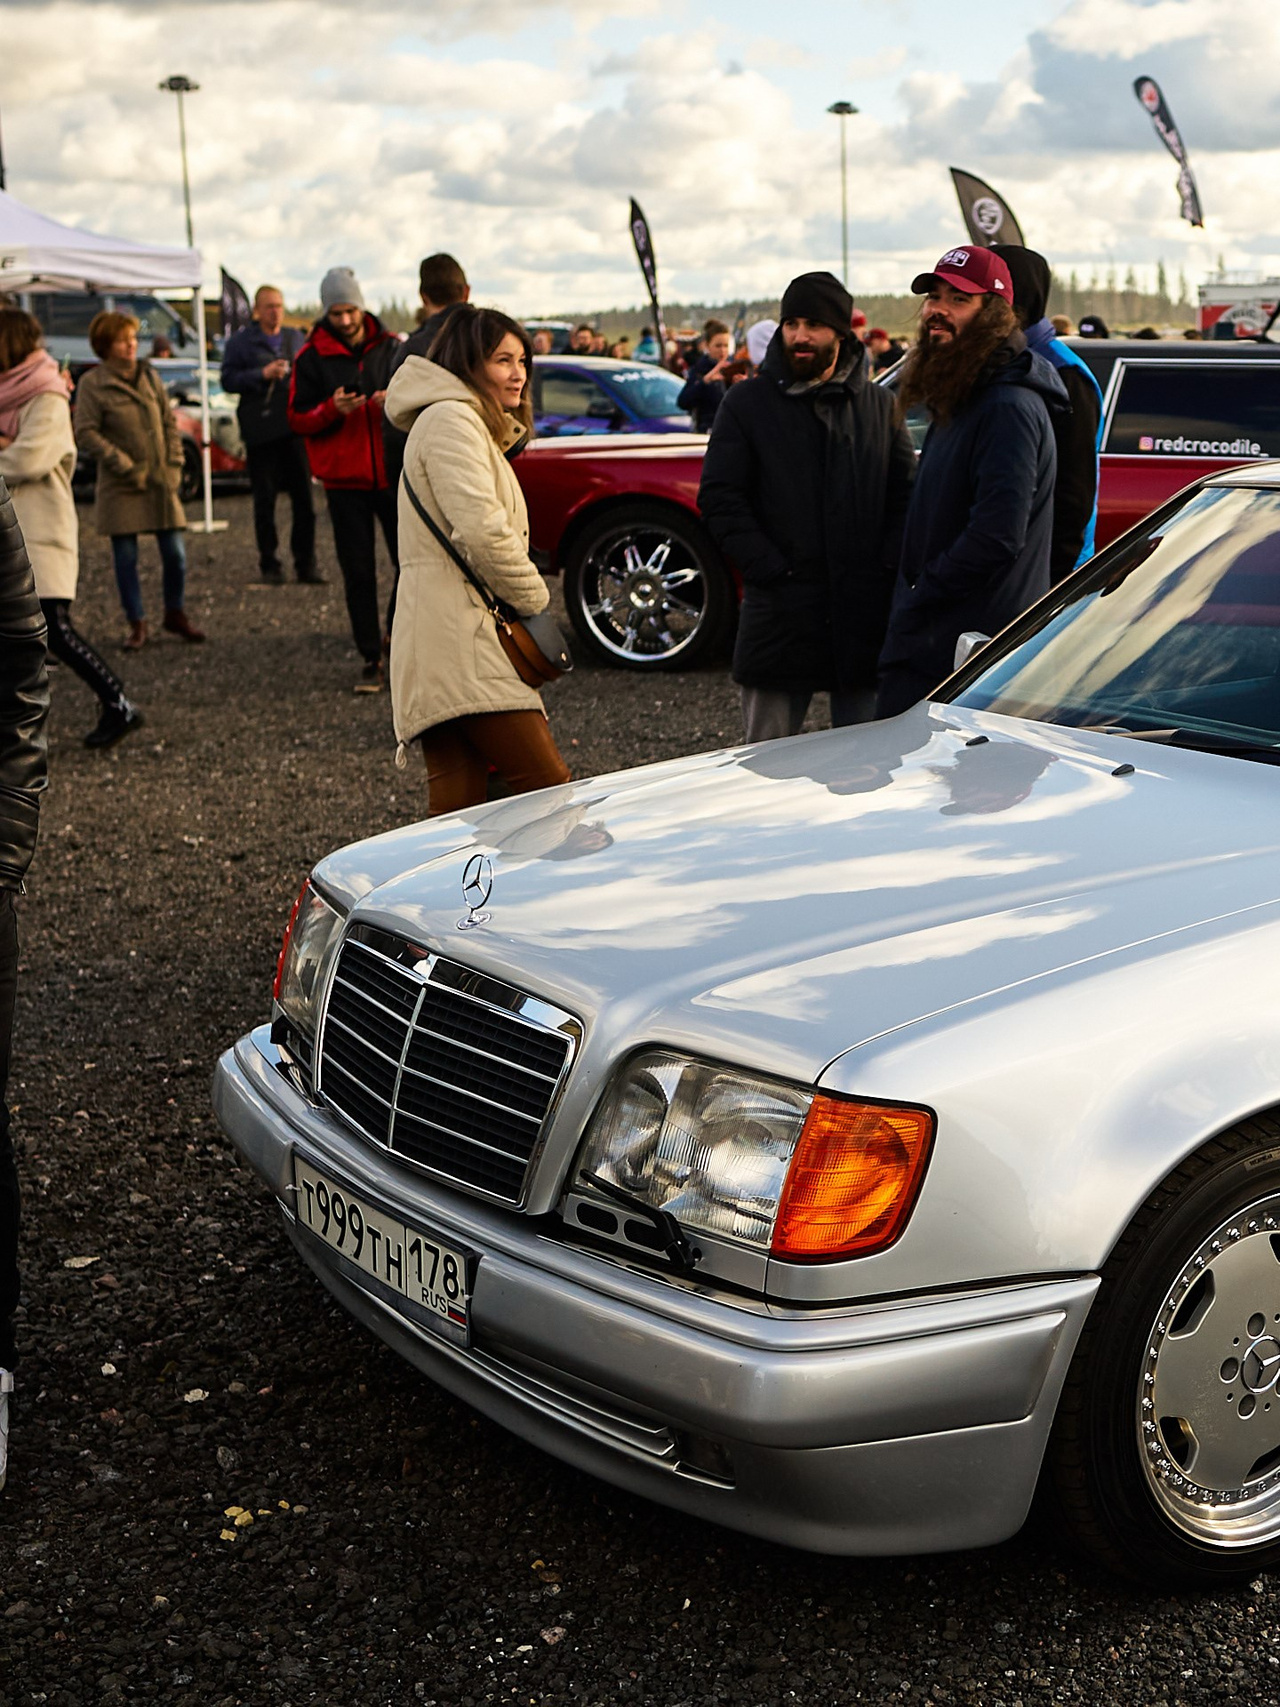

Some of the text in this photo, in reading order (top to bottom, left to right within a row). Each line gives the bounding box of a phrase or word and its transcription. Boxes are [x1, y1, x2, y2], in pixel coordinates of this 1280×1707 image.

[1154, 436, 1269, 458] redcrocodile_
[302, 1179, 460, 1300] T999TH 178
[421, 1287, 447, 1314] RUS
